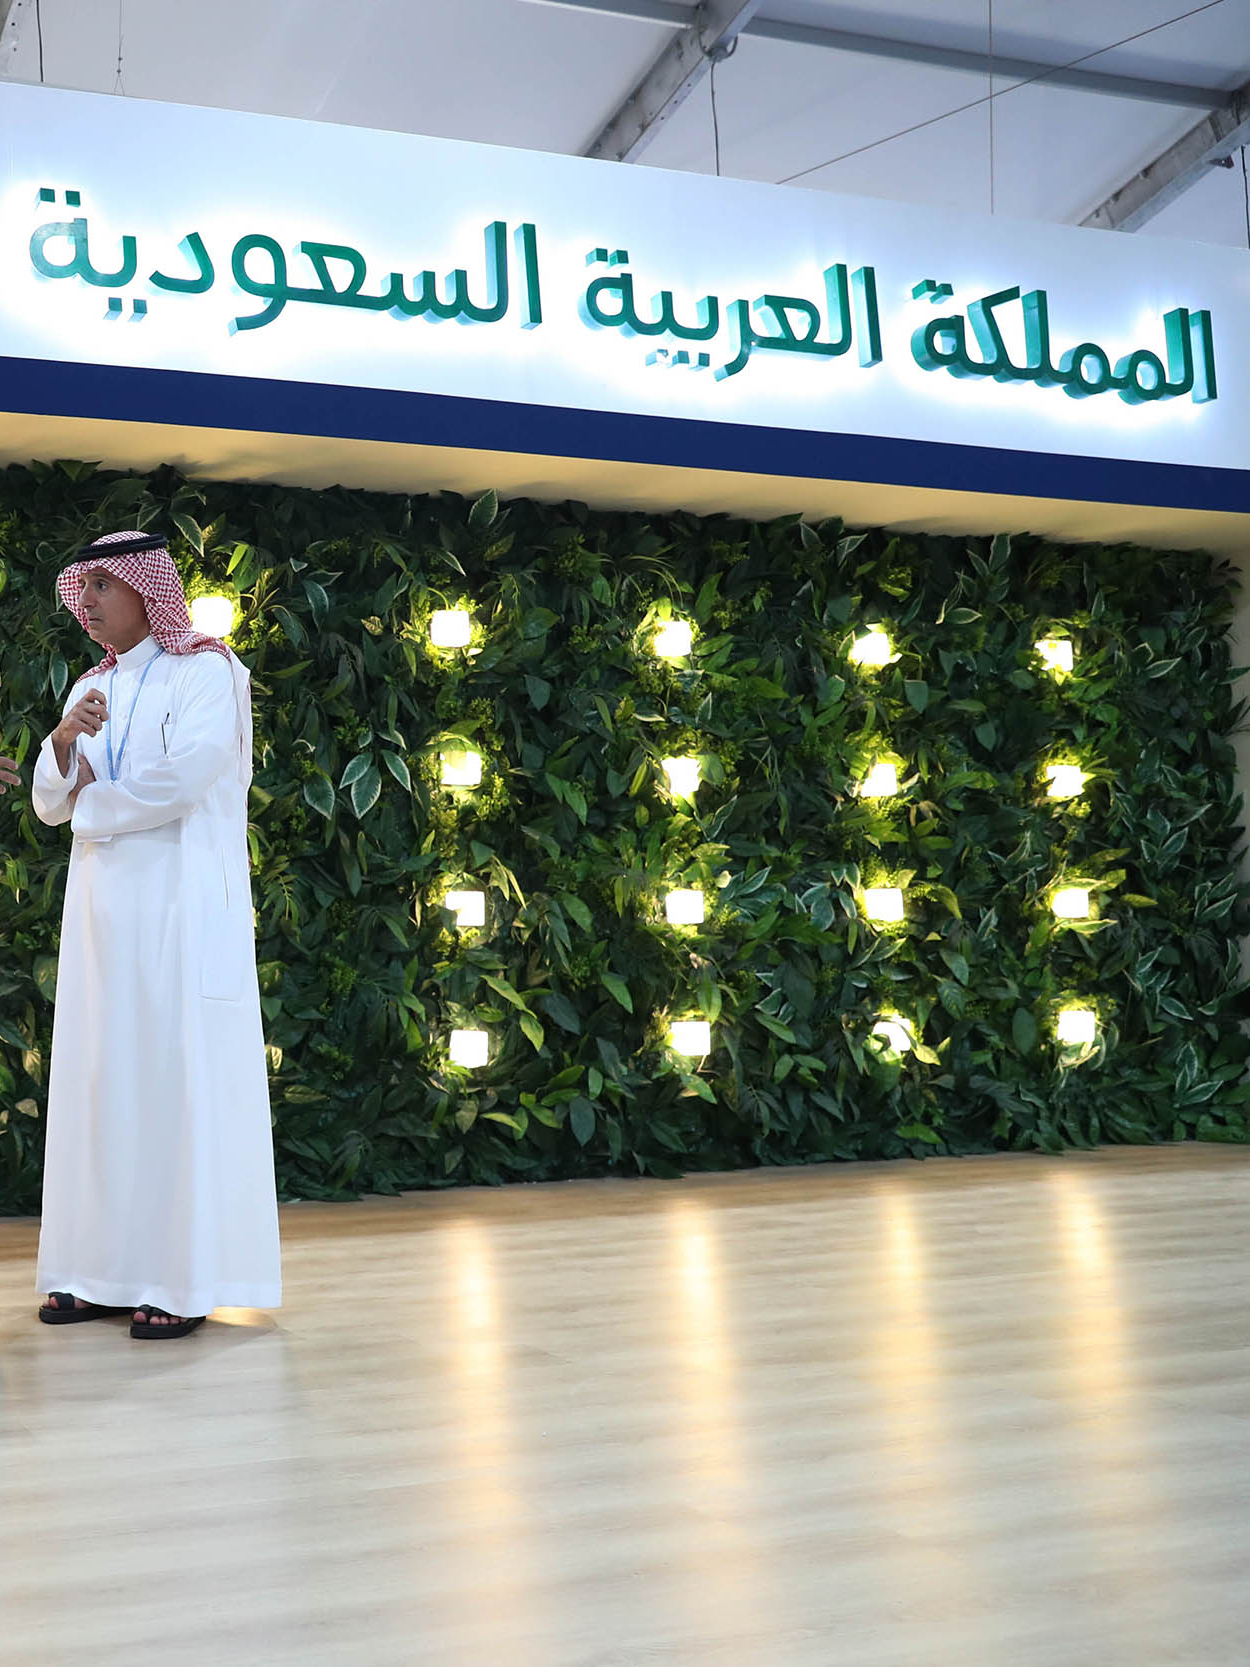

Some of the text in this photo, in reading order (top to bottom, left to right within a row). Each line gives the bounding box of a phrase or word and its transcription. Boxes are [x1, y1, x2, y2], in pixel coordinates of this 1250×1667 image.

[29, 187, 1218, 405] المملكة العربية السعودية
